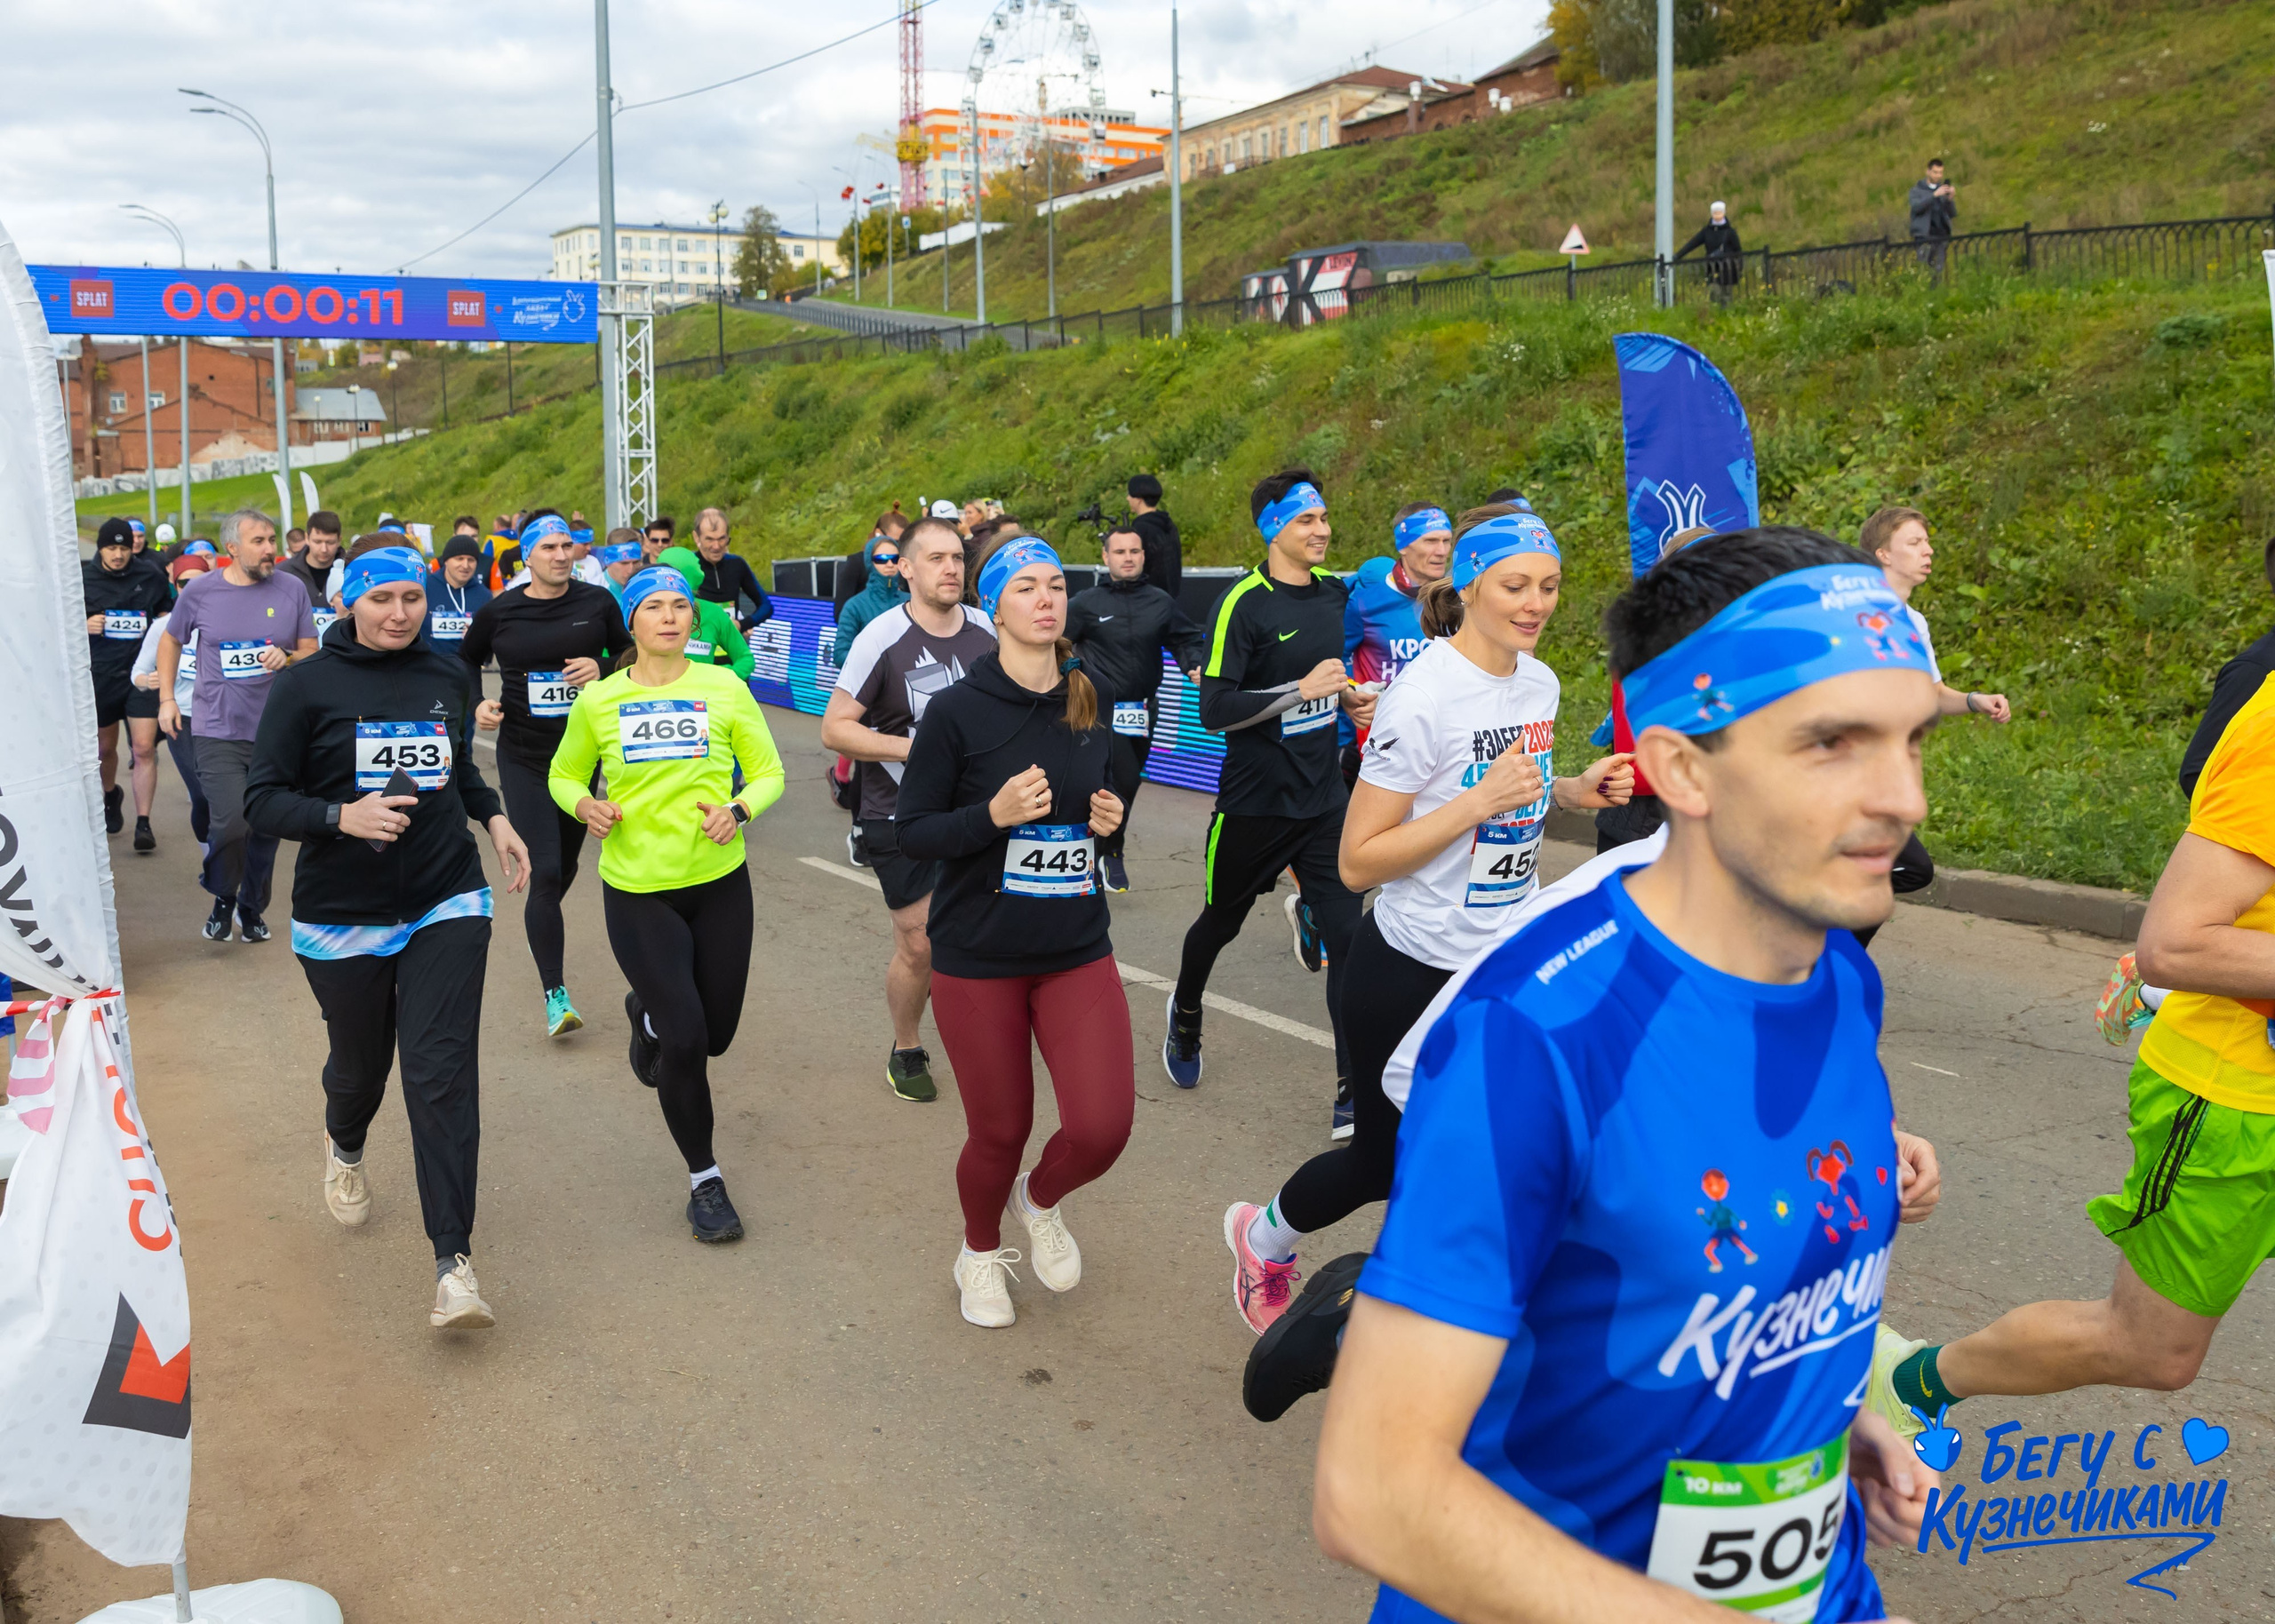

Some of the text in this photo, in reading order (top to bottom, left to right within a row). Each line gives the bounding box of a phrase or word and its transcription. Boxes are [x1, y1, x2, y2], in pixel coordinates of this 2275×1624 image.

[76, 291, 108, 308] SPLAT
[162, 282, 403, 325] 00:00:11
[452, 301, 481, 317] SPLAT
[111, 620, 141, 630] 424
[540, 686, 579, 702] 416
[1116, 713, 1145, 725] 425
[632, 718, 698, 740] 466
[371, 744, 441, 768] 453
[1019, 848, 1088, 873] 443
[1684, 1476, 1711, 1494] 10
[1693, 1494, 1841, 1590] 505
